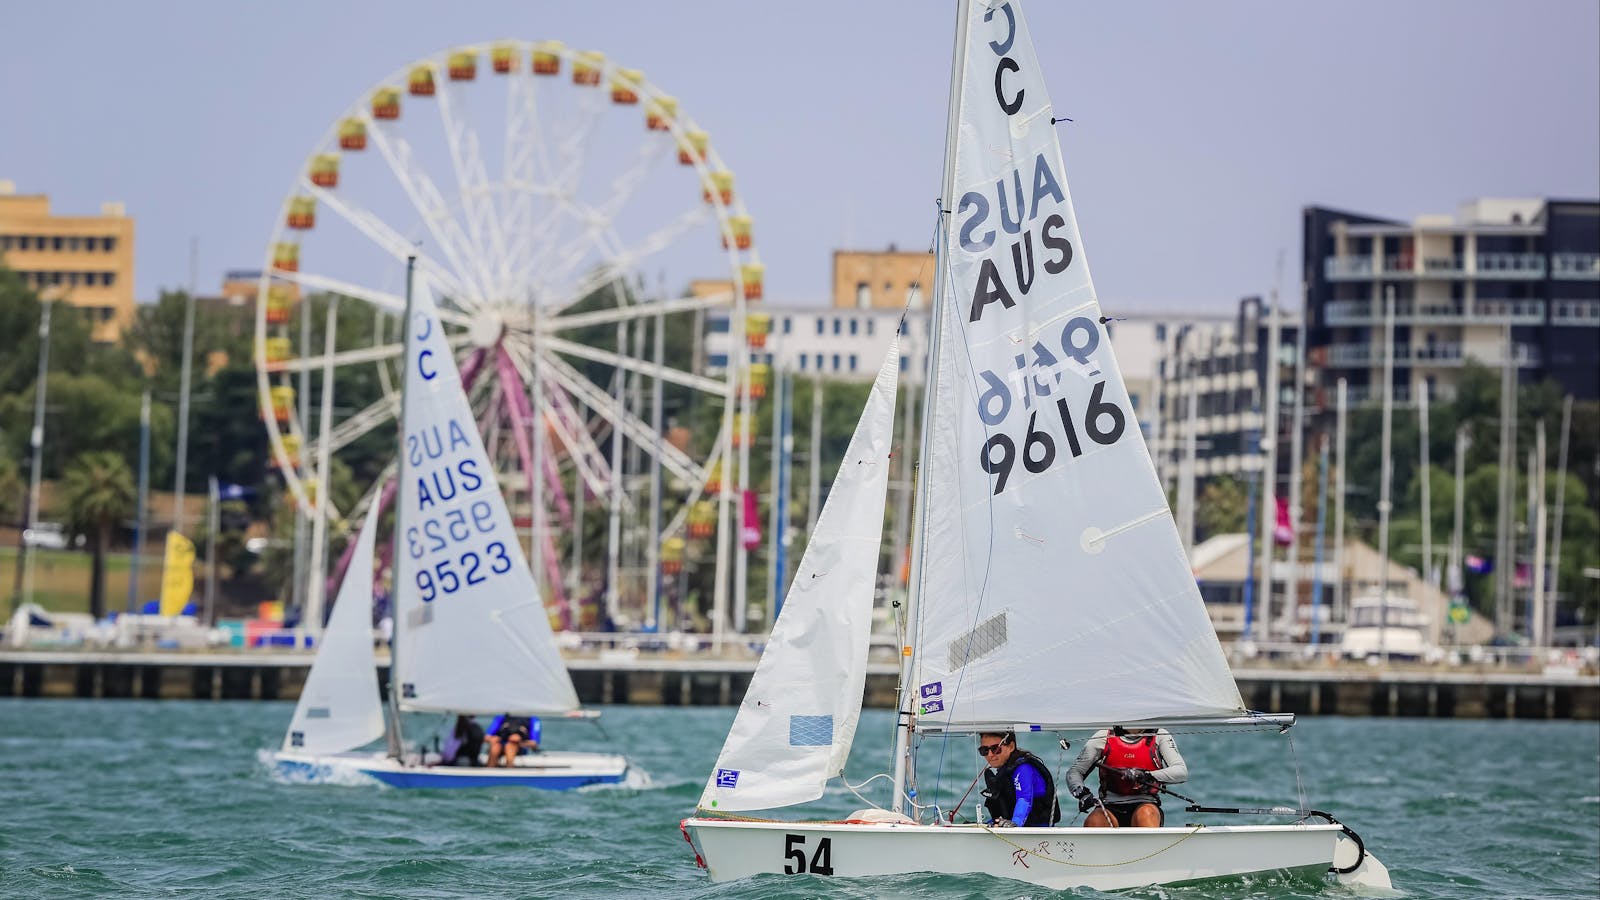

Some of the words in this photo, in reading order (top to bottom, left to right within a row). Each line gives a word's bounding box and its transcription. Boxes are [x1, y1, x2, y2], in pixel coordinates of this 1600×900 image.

[995, 57, 1025, 116] C
[969, 213, 1073, 323] AUS
[418, 350, 437, 380] C
[980, 380, 1126, 496] 9616
[418, 460, 482, 511] AUS
[415, 541, 512, 602] 9523
[784, 834, 834, 875] 54
